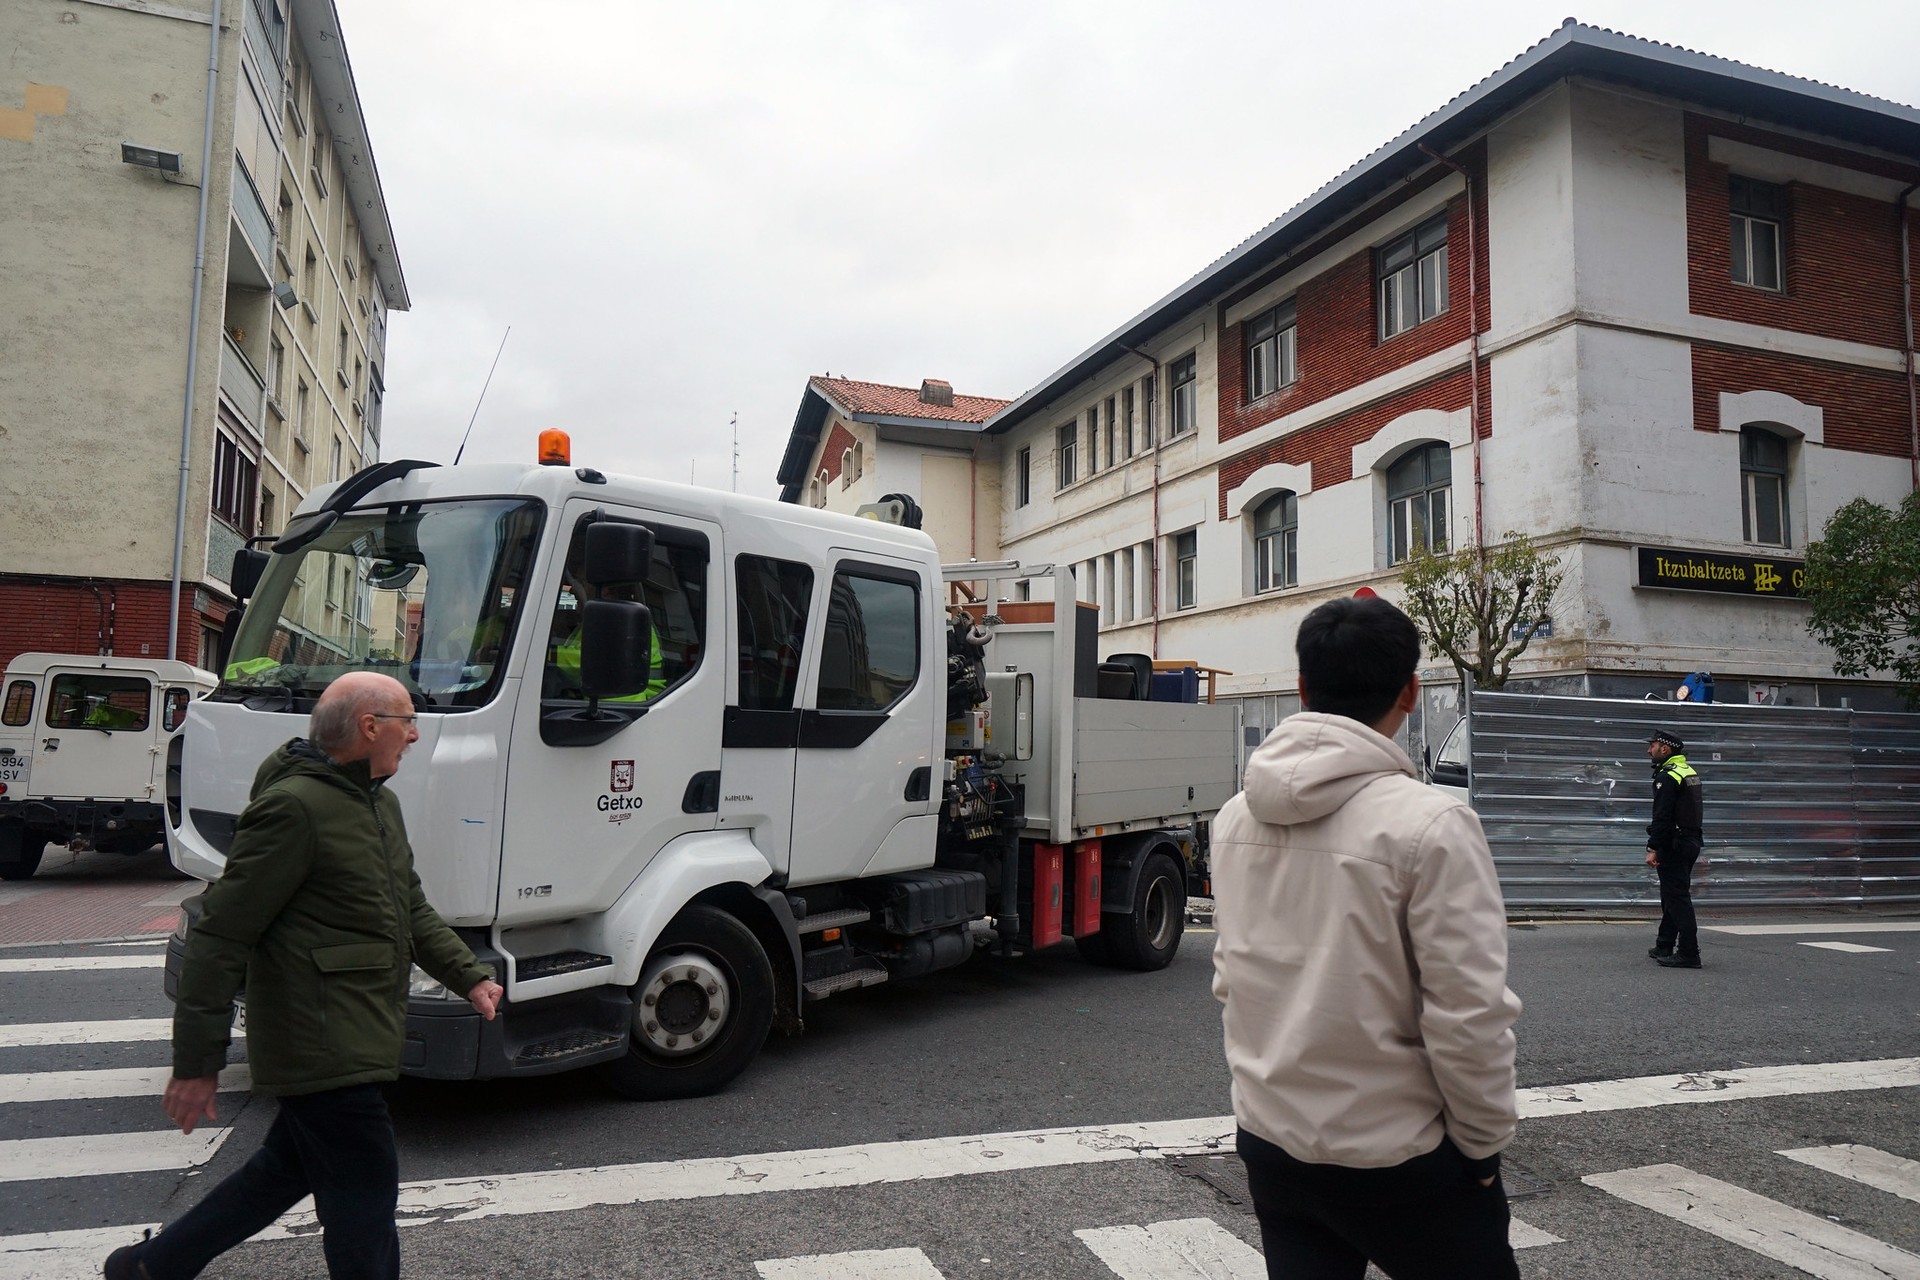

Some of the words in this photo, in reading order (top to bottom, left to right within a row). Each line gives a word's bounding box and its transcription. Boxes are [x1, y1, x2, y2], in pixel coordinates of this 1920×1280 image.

[1656, 557, 1746, 581] Itzubaltzeta
[0, 757, 24, 768] 994
[597, 794, 643, 812] Getxo
